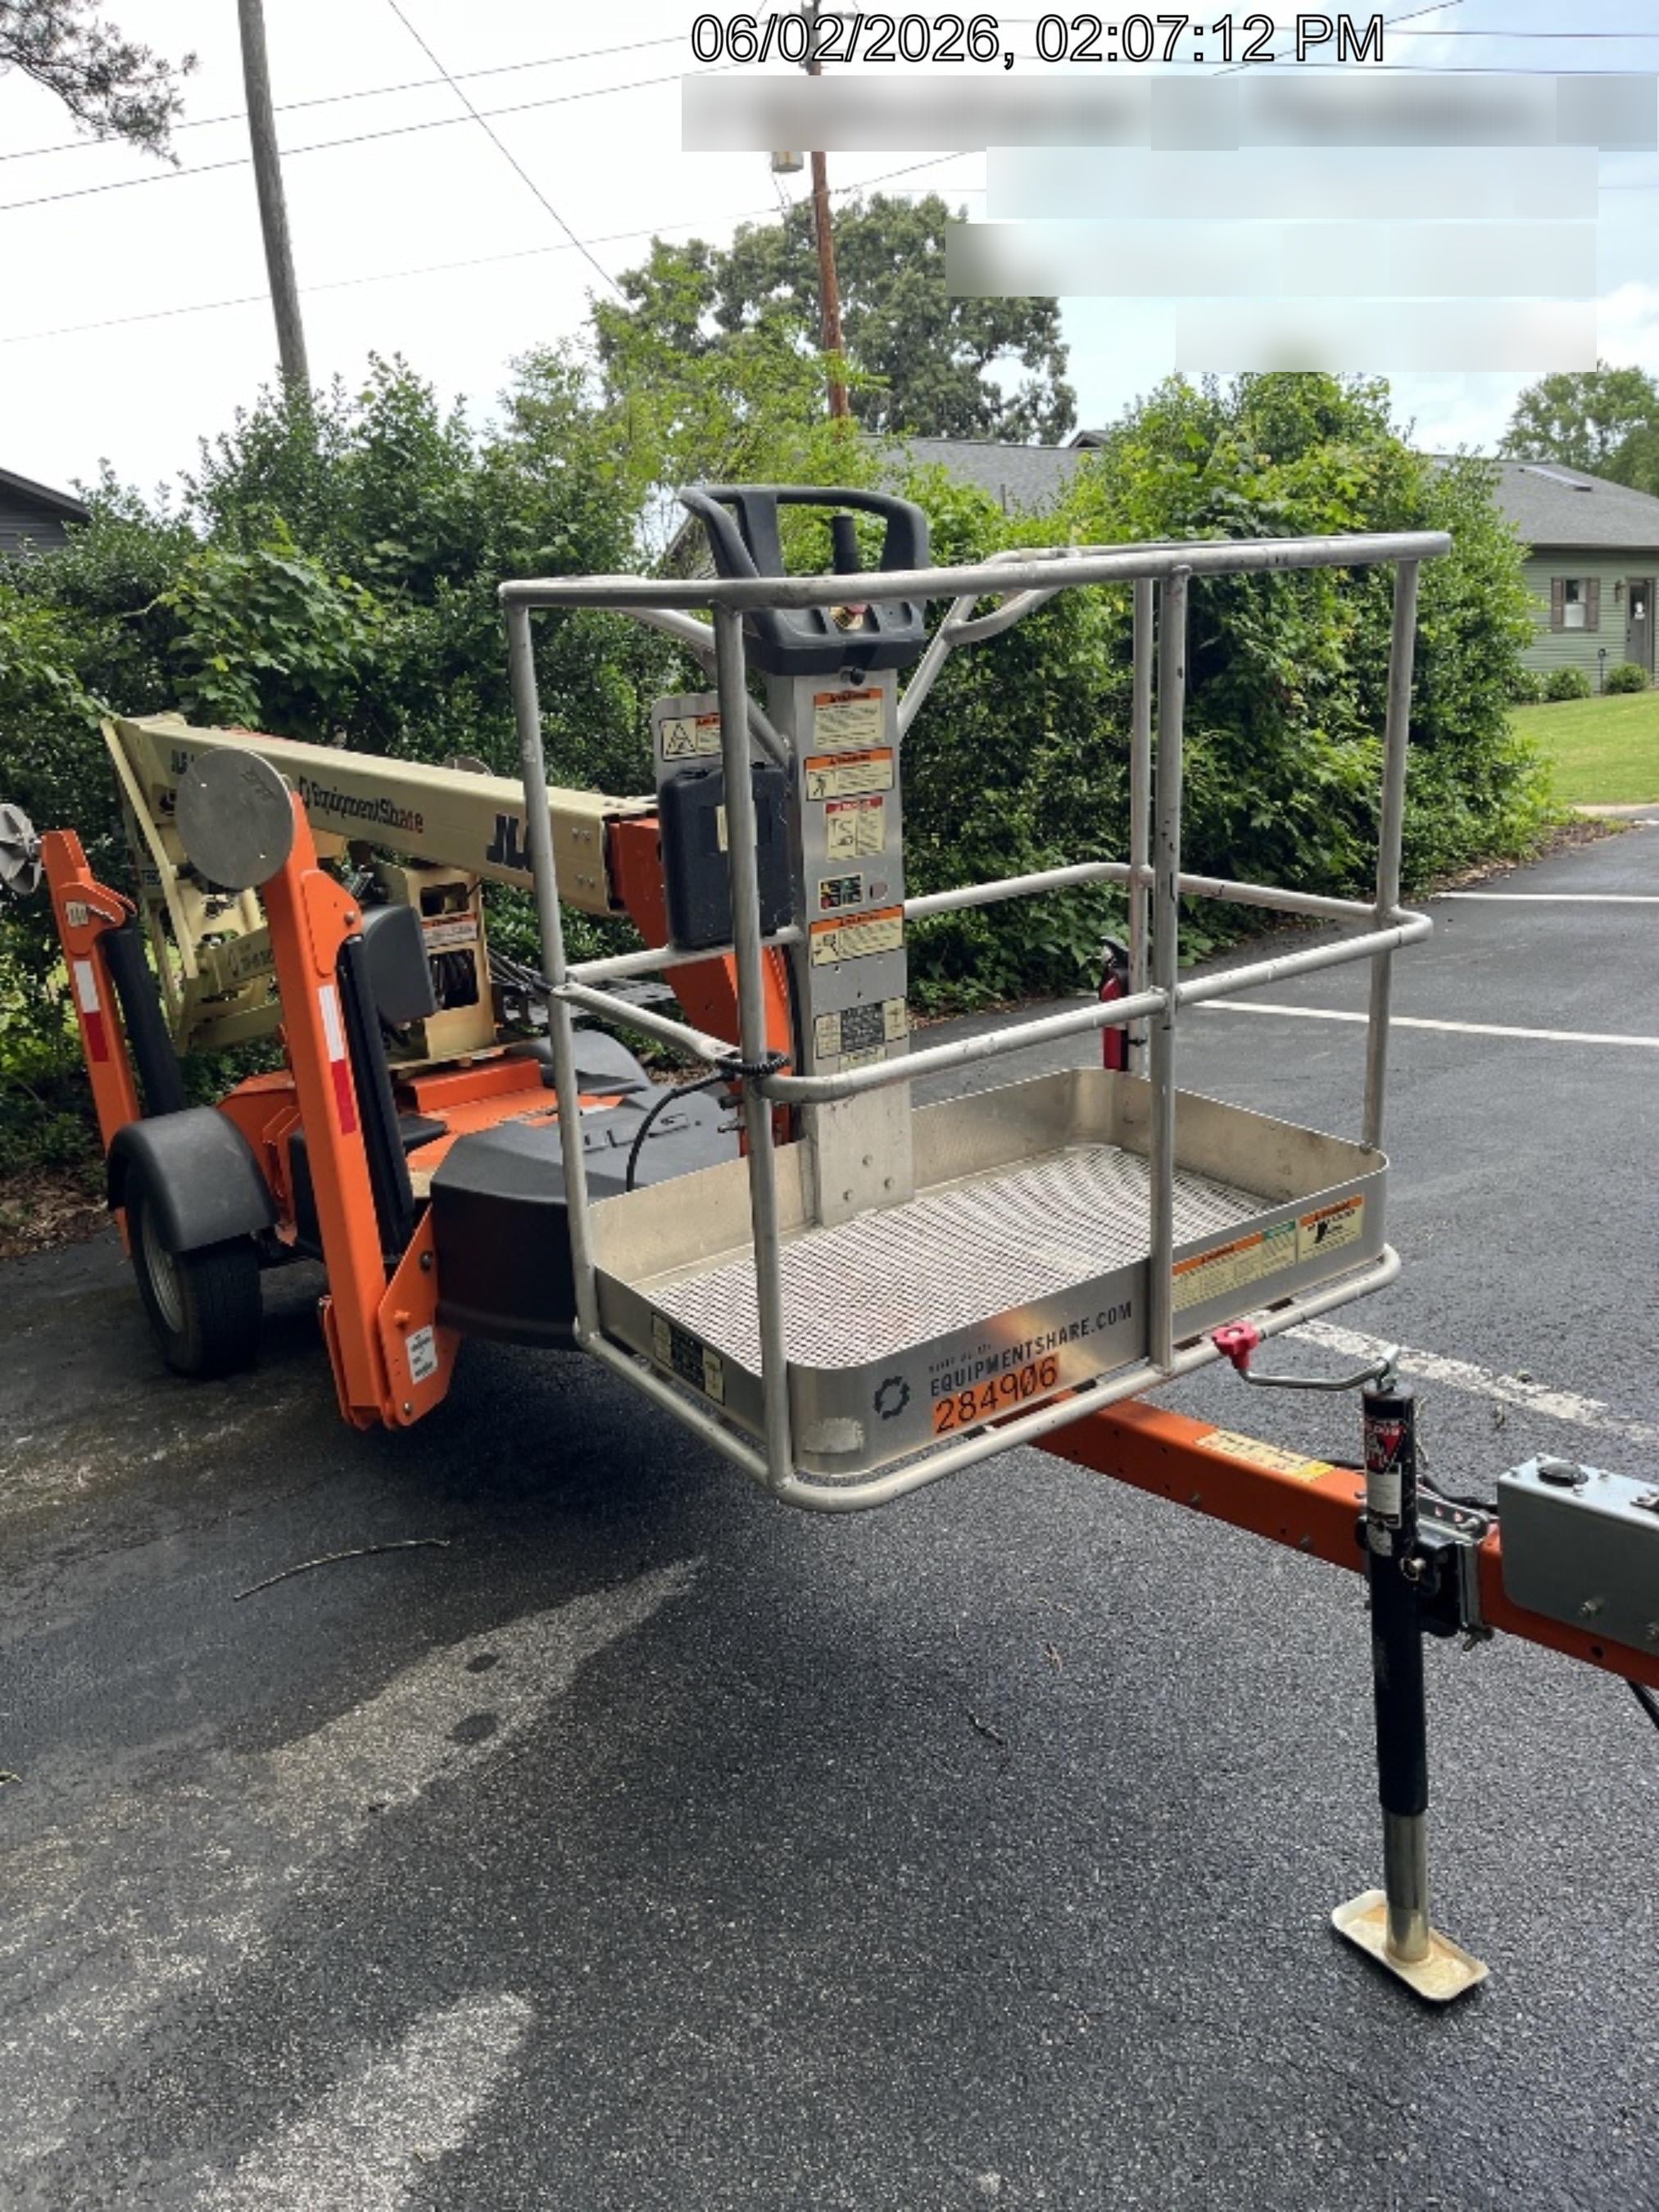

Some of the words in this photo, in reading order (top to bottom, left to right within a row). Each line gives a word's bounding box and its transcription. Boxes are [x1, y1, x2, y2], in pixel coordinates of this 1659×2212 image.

[310, 780, 424, 834] EquipmentShare
[486, 813, 533, 870] JL
[930, 1300, 1133, 1398] EQUIPMENTSHARE.COM
[935, 1356, 1058, 1434] 284906
